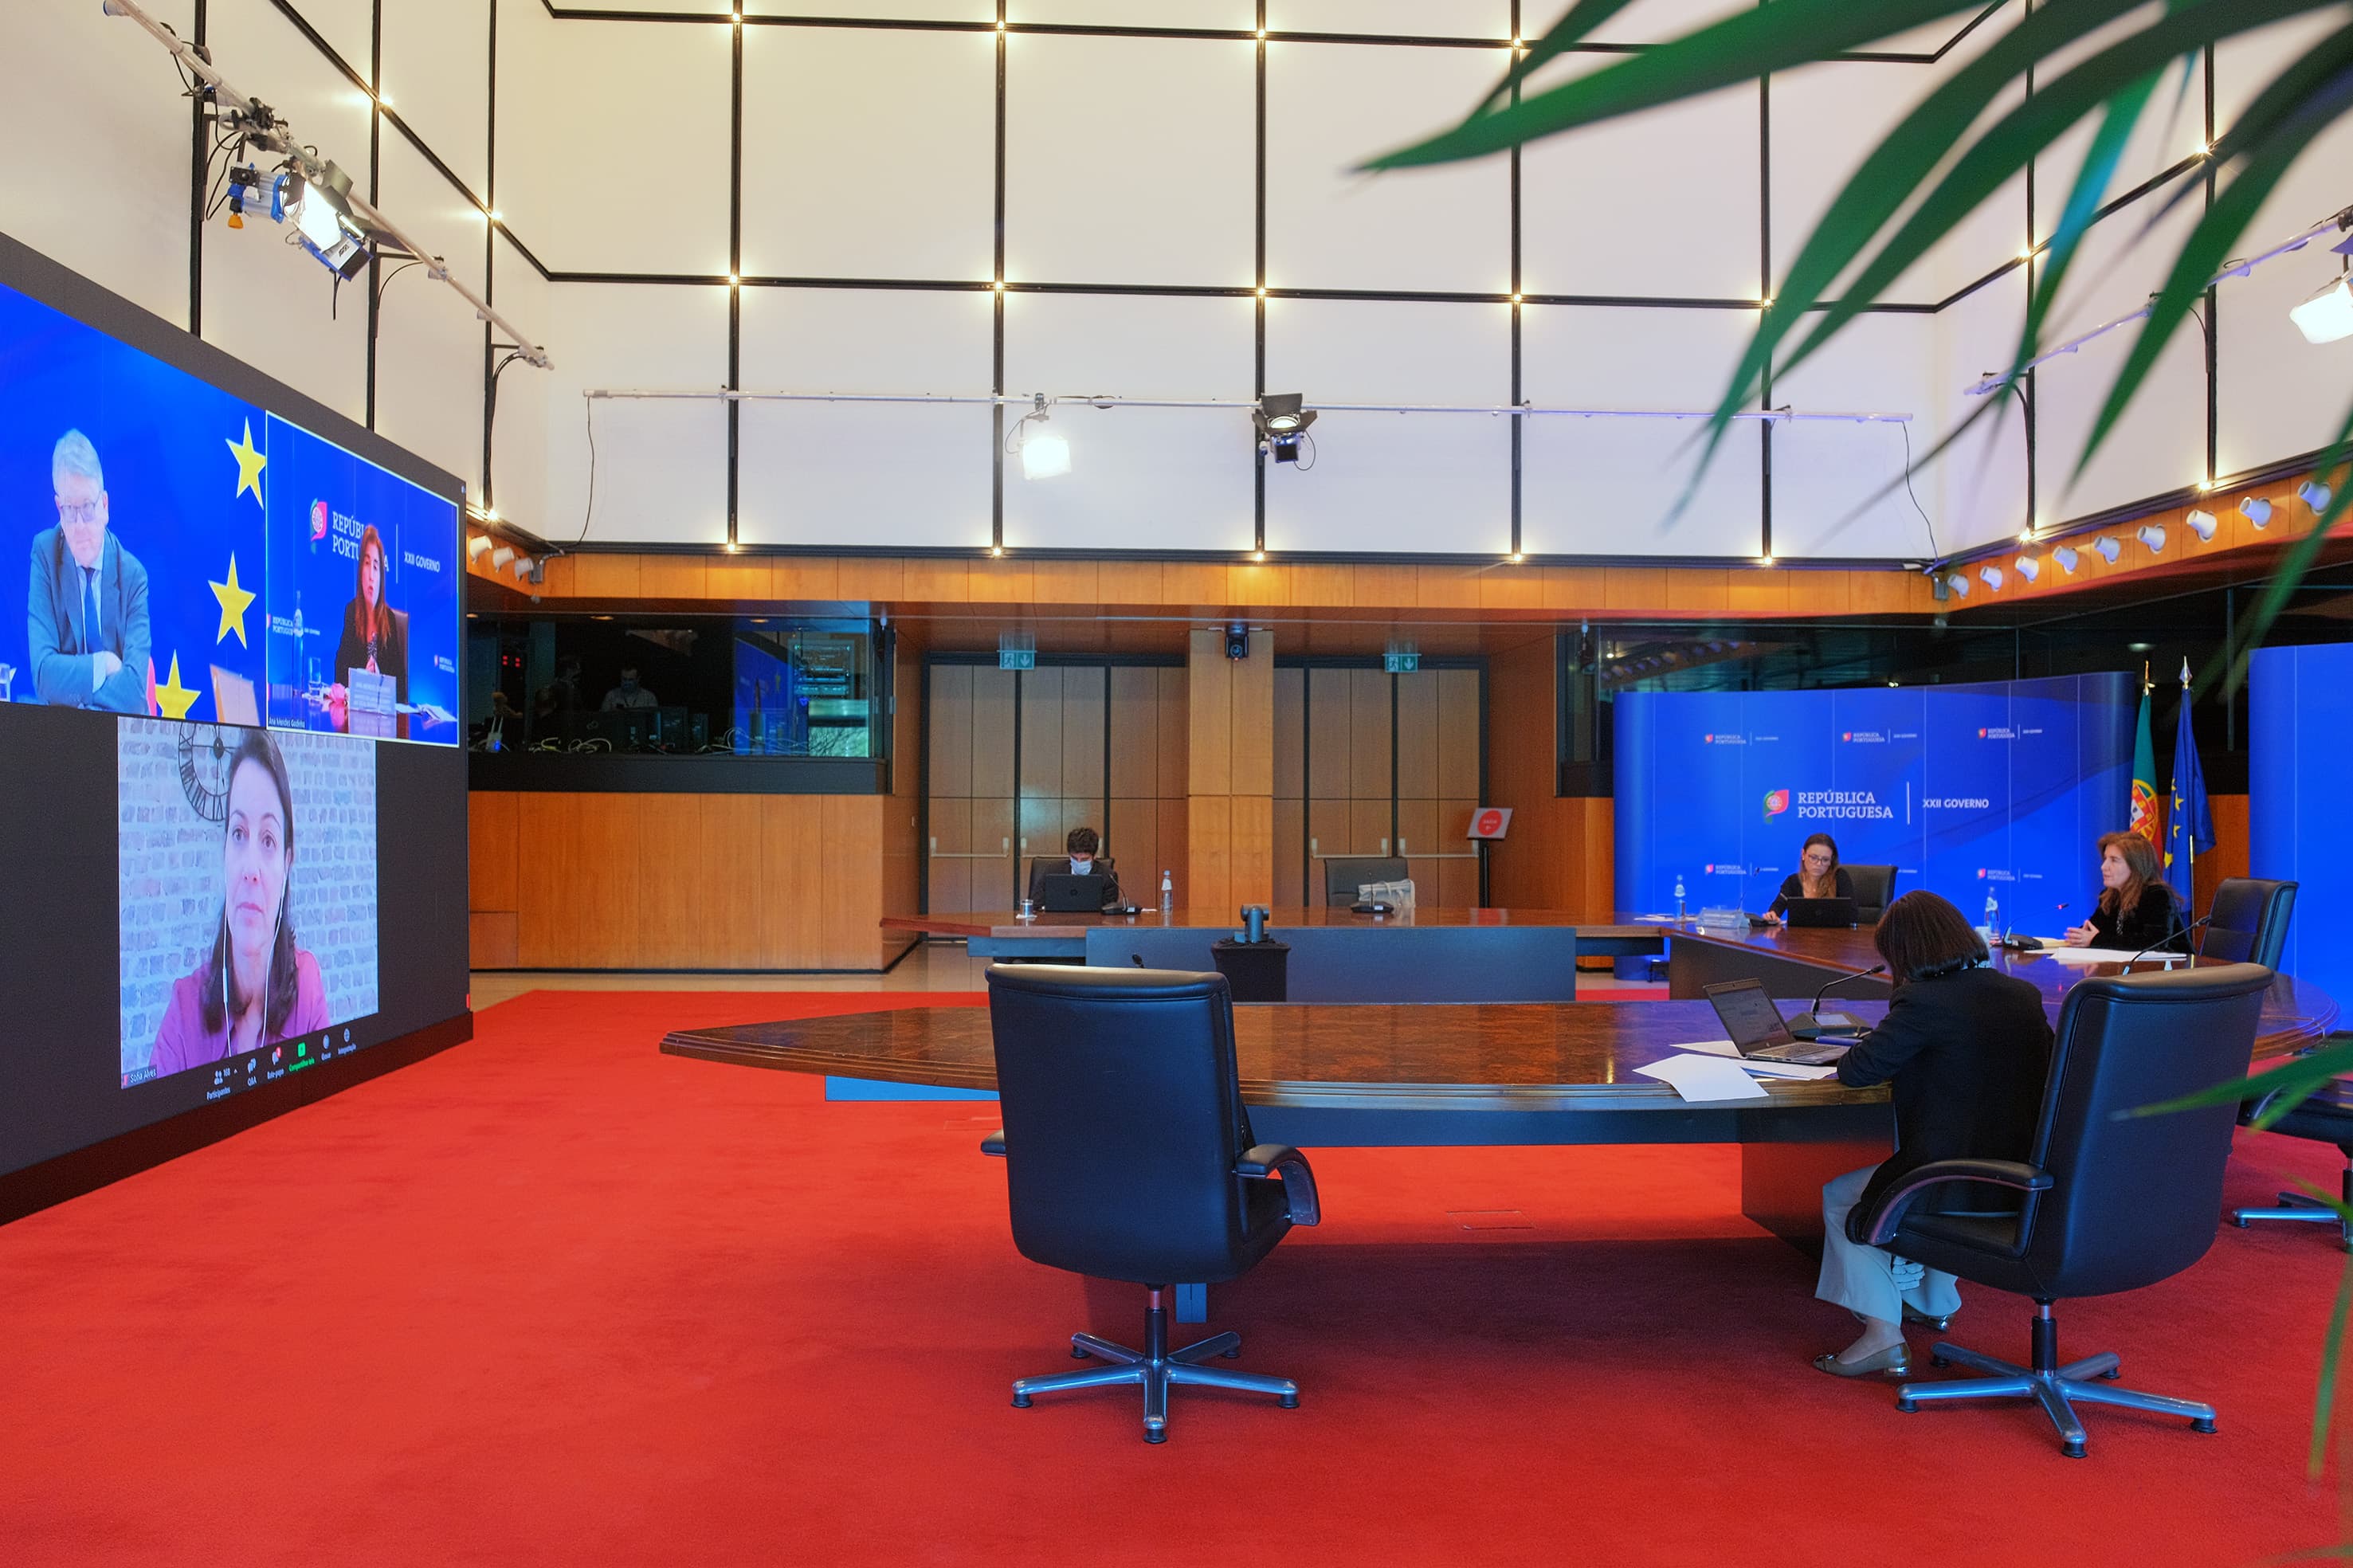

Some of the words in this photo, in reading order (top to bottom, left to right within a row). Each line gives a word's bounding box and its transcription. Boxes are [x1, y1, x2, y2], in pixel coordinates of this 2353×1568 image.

[332, 511, 365, 539] REPÚB
[404, 551, 415, 566] XXII
[416, 555, 441, 573] GOVERNO
[1798, 789, 1876, 805] REPÚBLICA
[1922, 798, 1942, 809] XXII
[1944, 798, 1990, 809] GOVERNO
[1798, 806, 1894, 819] PORTUGUESA
